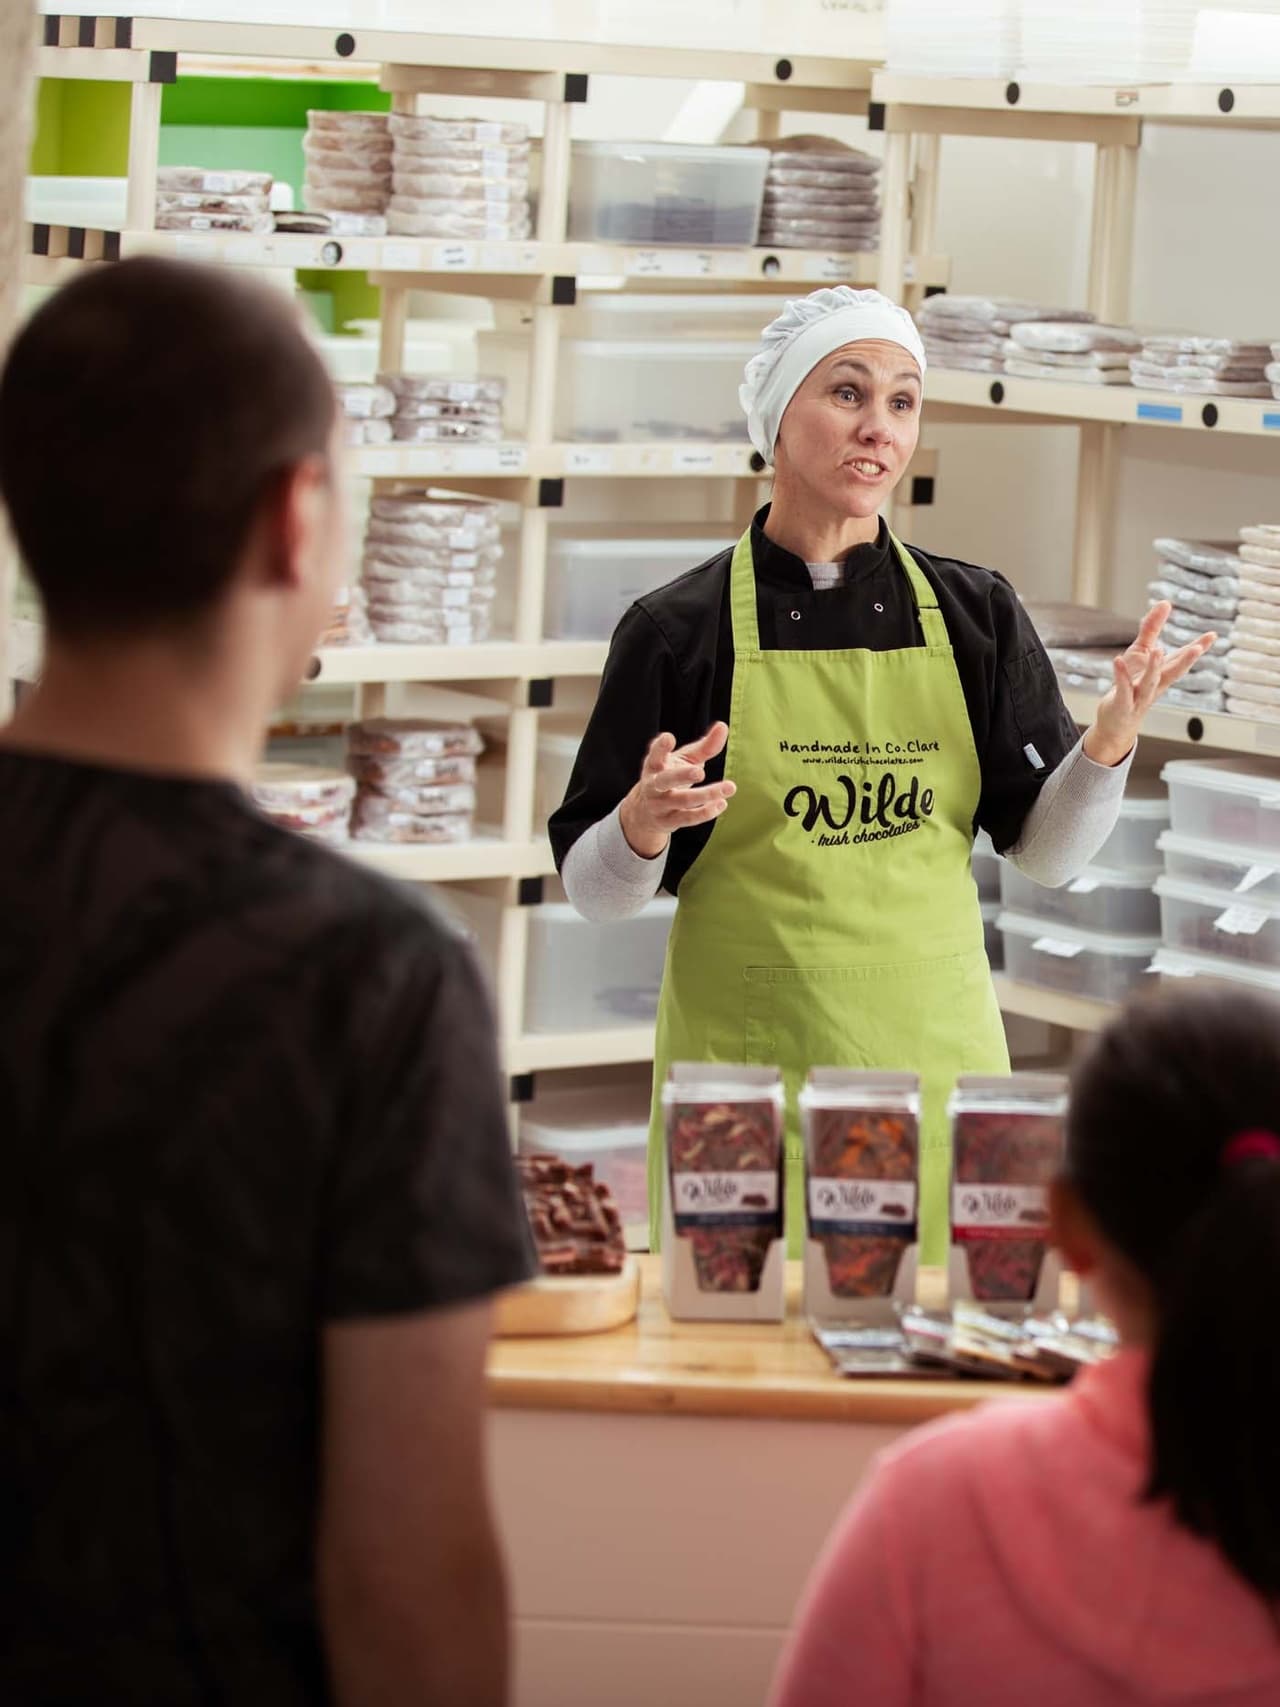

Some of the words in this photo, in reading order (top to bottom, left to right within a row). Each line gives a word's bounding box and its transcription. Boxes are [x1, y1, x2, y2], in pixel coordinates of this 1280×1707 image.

[779, 740, 861, 754] Handmade
[865, 742, 881, 754] In
[802, 756, 924, 766] www.wildeirishchocolates.com
[783, 772, 935, 832] Wilde
[817, 831, 851, 847] Irish
[853, 820, 921, 844] chocolates
